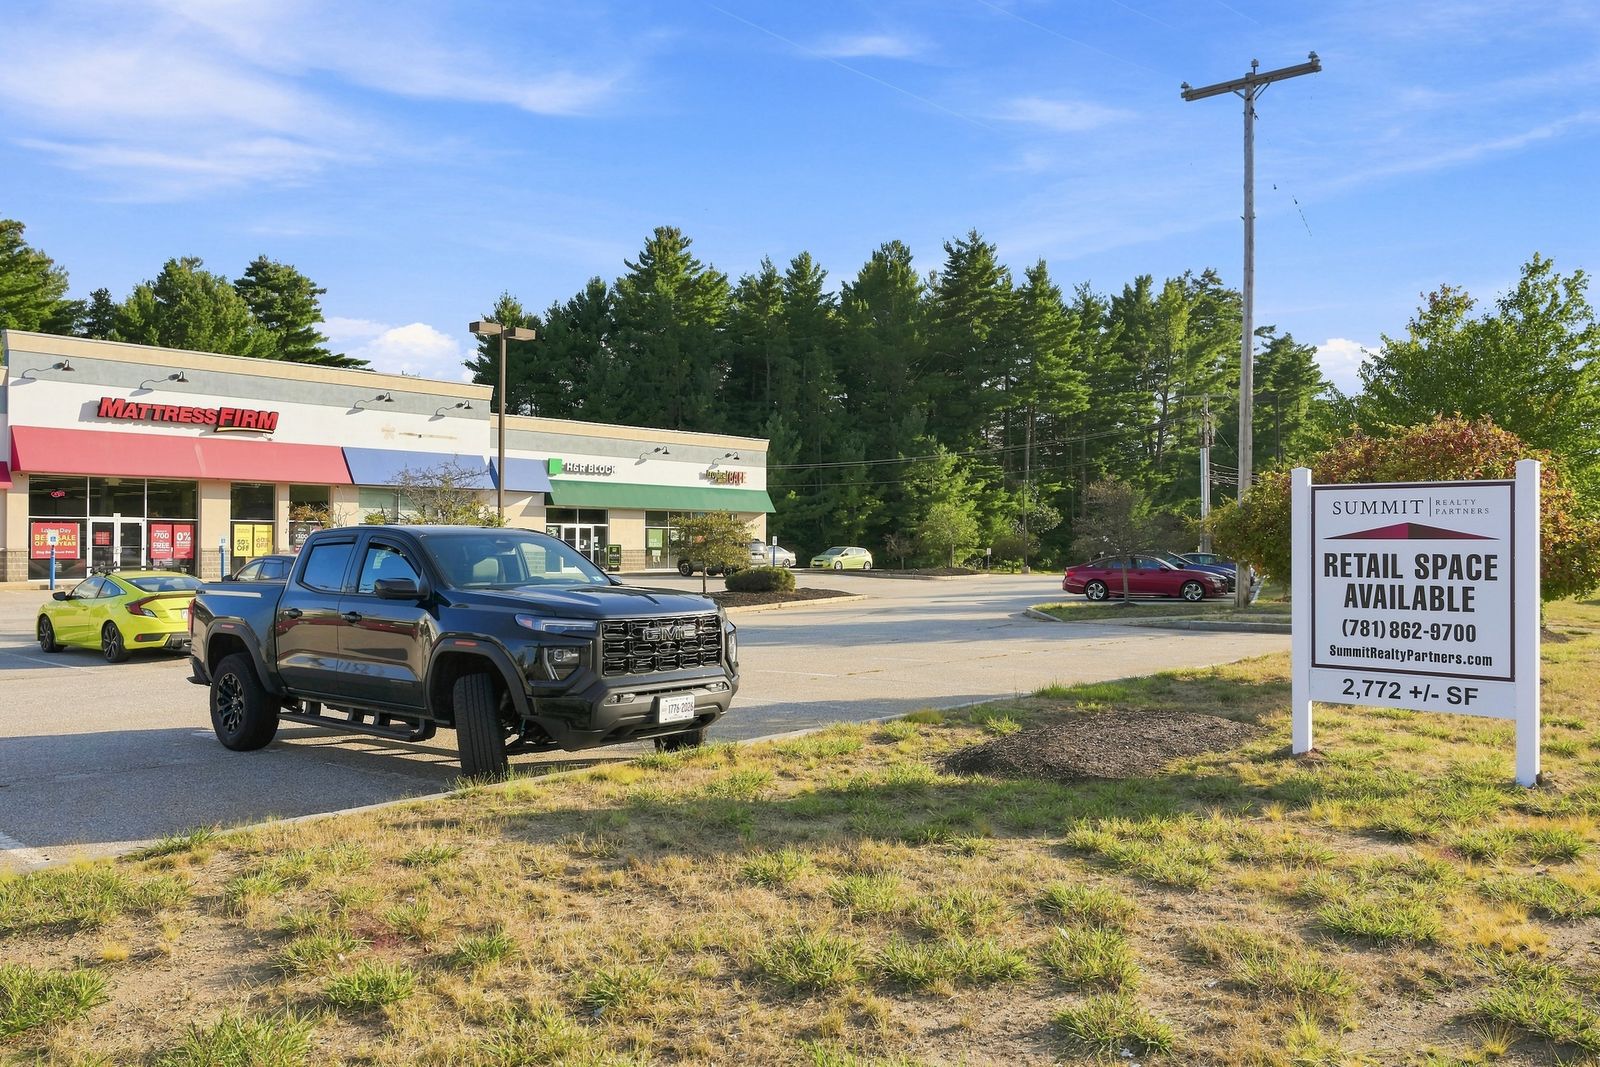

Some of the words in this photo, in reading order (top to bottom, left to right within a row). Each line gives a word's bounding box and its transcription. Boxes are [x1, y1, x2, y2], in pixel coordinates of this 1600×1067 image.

[98, 397, 217, 425] MATTRESS
[217, 407, 279, 430] FIRM
[566, 462, 585, 472] H&R
[588, 464, 615, 474] BLOCK
[1331, 500, 1424, 515] SUMMIT
[1435, 507, 1490, 515] PARTNERS
[176, 532, 191, 541] 0%
[1323, 552, 1403, 579] RETAIL
[1414, 553, 1498, 581] SPACE
[1343, 583, 1475, 612] AVAILABLE
[643, 624, 697, 640] GMC
[1342, 619, 1385, 639] (781)
[1389, 621, 1477, 643] 862-9700
[1329, 644, 1493, 667] SummitRealtyPartners.com
[1342, 678, 1401, 700] 2,772
[1409, 684, 1440, 702] +/-
[1446, 686, 1479, 706] SF
